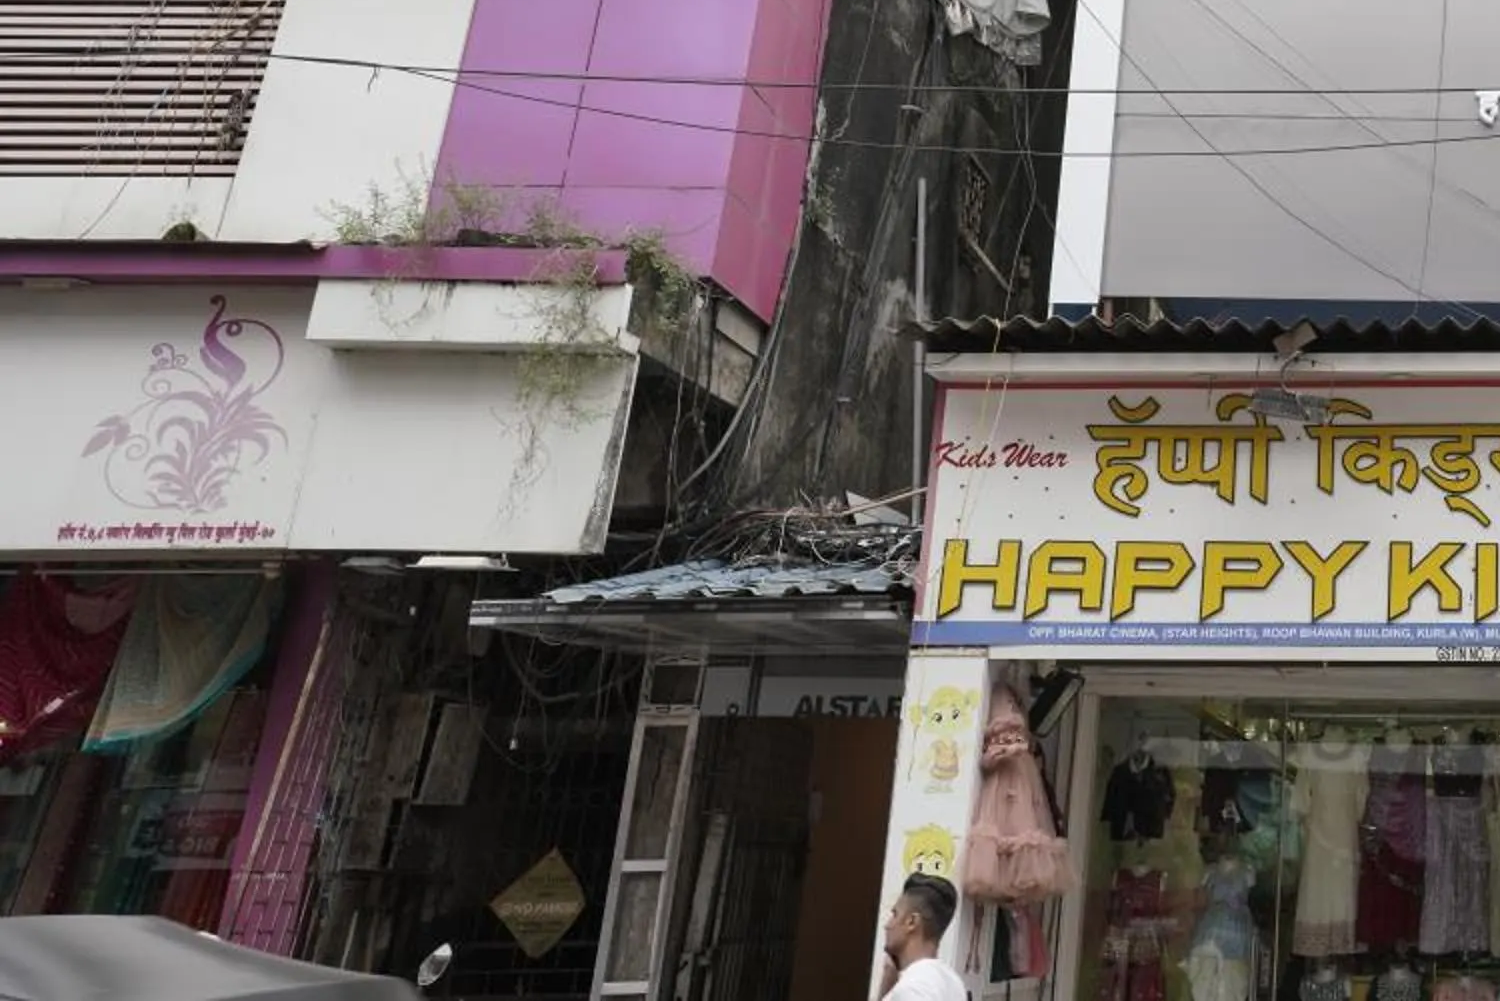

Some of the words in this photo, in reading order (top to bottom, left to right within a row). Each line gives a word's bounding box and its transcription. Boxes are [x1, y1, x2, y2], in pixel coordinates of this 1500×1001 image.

[934, 441, 998, 468] Kids
[1001, 442, 1069, 468] Wear
[936, 539, 1371, 622] HAPPY
[1058, 627, 1106, 639] BHARAT
[1416, 628, 1458, 639] KURLA
